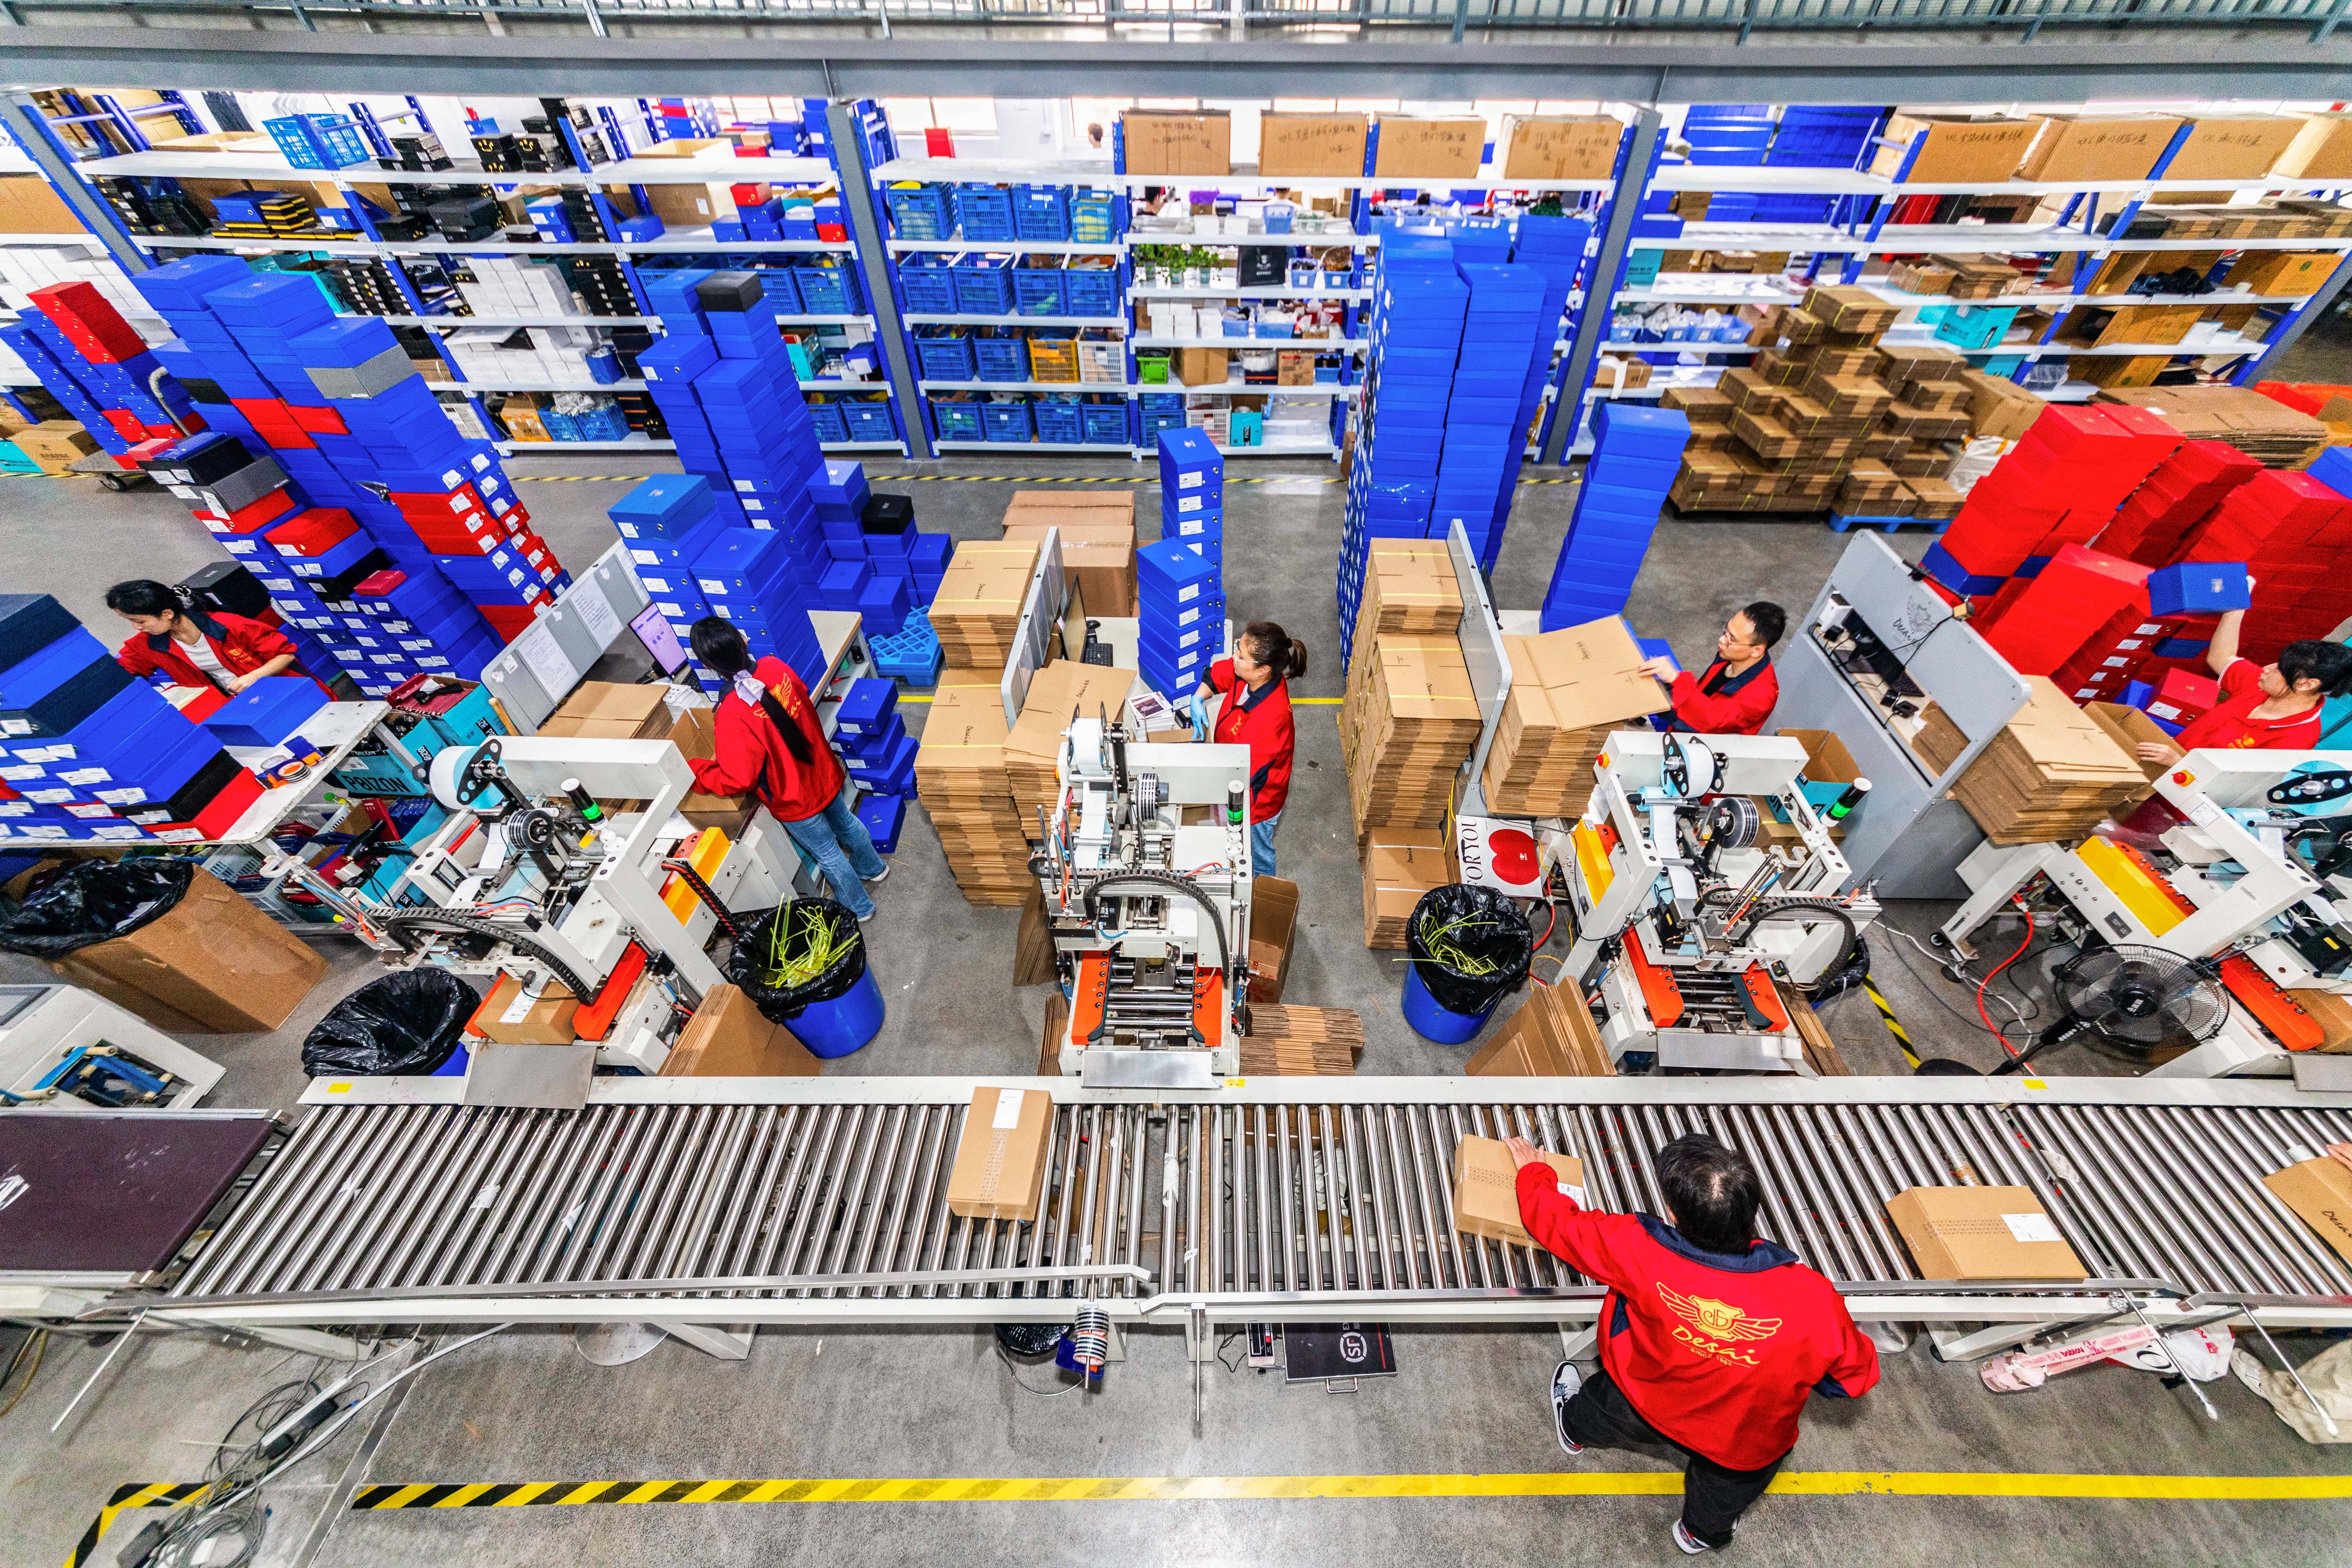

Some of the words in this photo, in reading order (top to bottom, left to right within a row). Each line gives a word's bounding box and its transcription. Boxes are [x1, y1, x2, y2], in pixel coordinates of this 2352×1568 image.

[1461, 816, 1479, 849] YOU
[1672, 1324, 1760, 1365] Desai
[1690, 1348, 1712, 1358] SINCE
[1716, 1355, 1732, 1366] 1993
